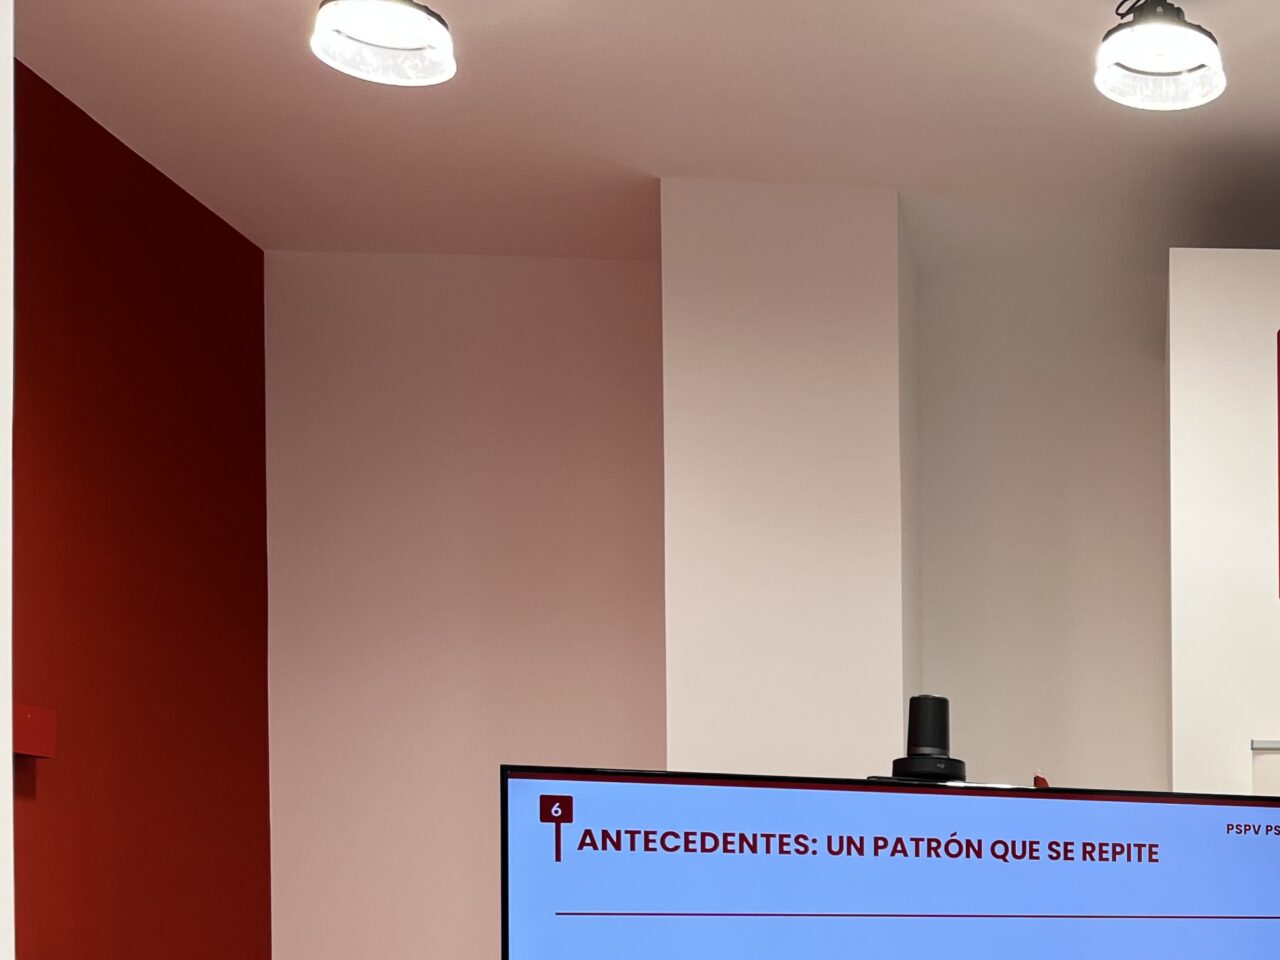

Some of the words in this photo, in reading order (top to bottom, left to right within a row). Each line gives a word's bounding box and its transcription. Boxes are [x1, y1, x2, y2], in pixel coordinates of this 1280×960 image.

[550, 802, 562, 817] 6
[1226, 823, 1262, 836] PSPV
[577, 828, 818, 856] ANTECEDENTES:
[826, 834, 865, 857] UN
[873, 831, 983, 859] PATRÓN
[989, 839, 1041, 863] QUE
[1047, 840, 1075, 862] SE
[1081, 841, 1160, 863] REPITE
